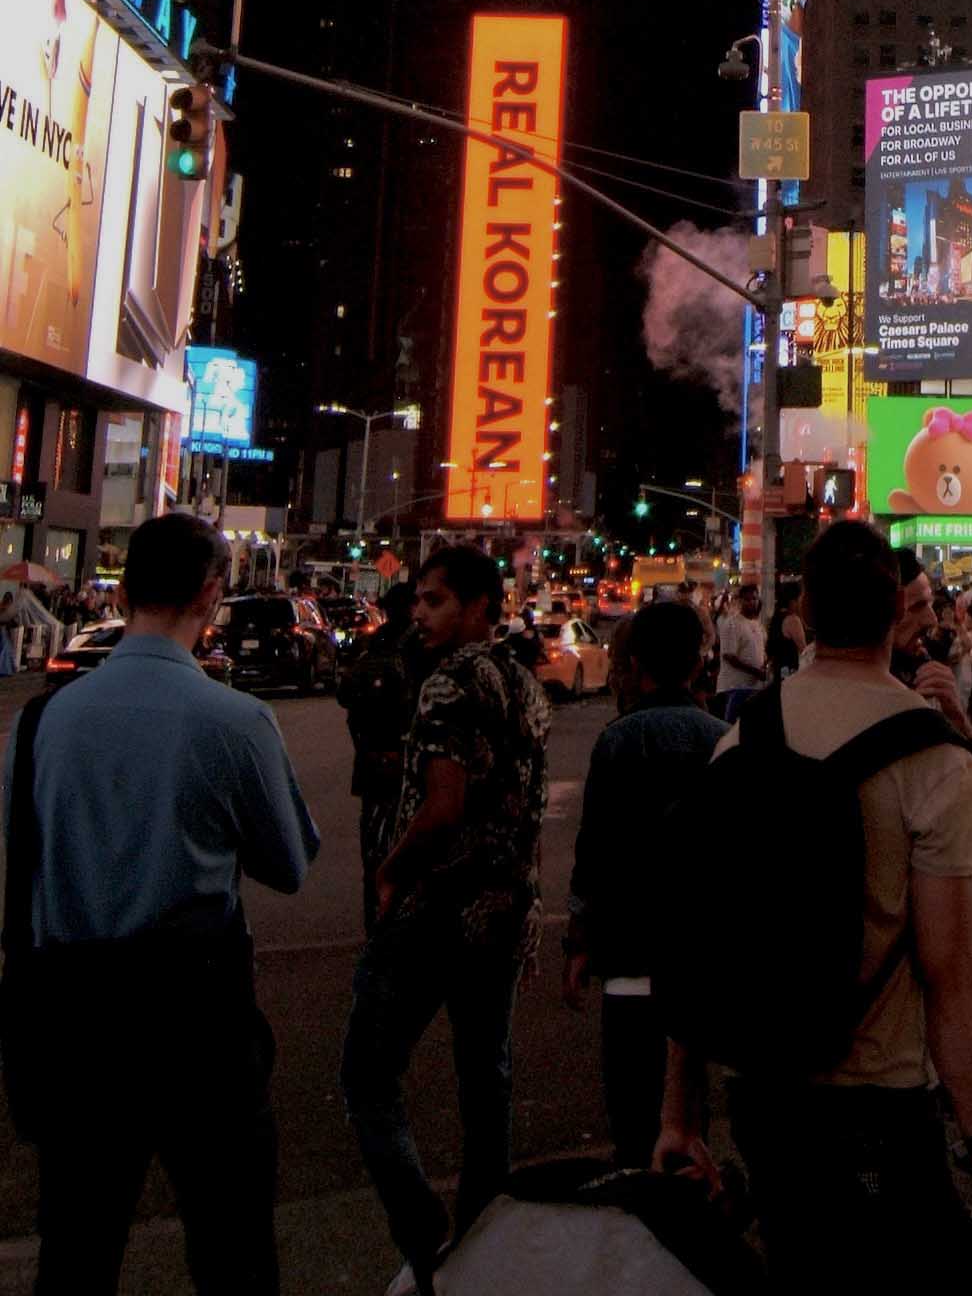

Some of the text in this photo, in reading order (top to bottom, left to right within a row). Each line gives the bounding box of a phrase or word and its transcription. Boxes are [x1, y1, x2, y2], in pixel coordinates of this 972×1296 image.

[881, 88, 916, 105] THE
[881, 105, 905, 122] OF
[908, 105, 921, 120] A
[20, 98, 40, 147] IN
[41, 115, 73, 170] NYC
[880, 125, 902, 137] FOR
[903, 123, 937, 136] LOCAL
[880, 135, 962, 152] FOR BROADWAY
[880, 150, 956, 166] FOR ALL OF US
[476, 60, 540, 472] REAL KOREAN
[878, 313, 926, 325] We Support
[879, 321, 969, 337] Caesars Palace
[879, 335, 960, 349] Times Square
